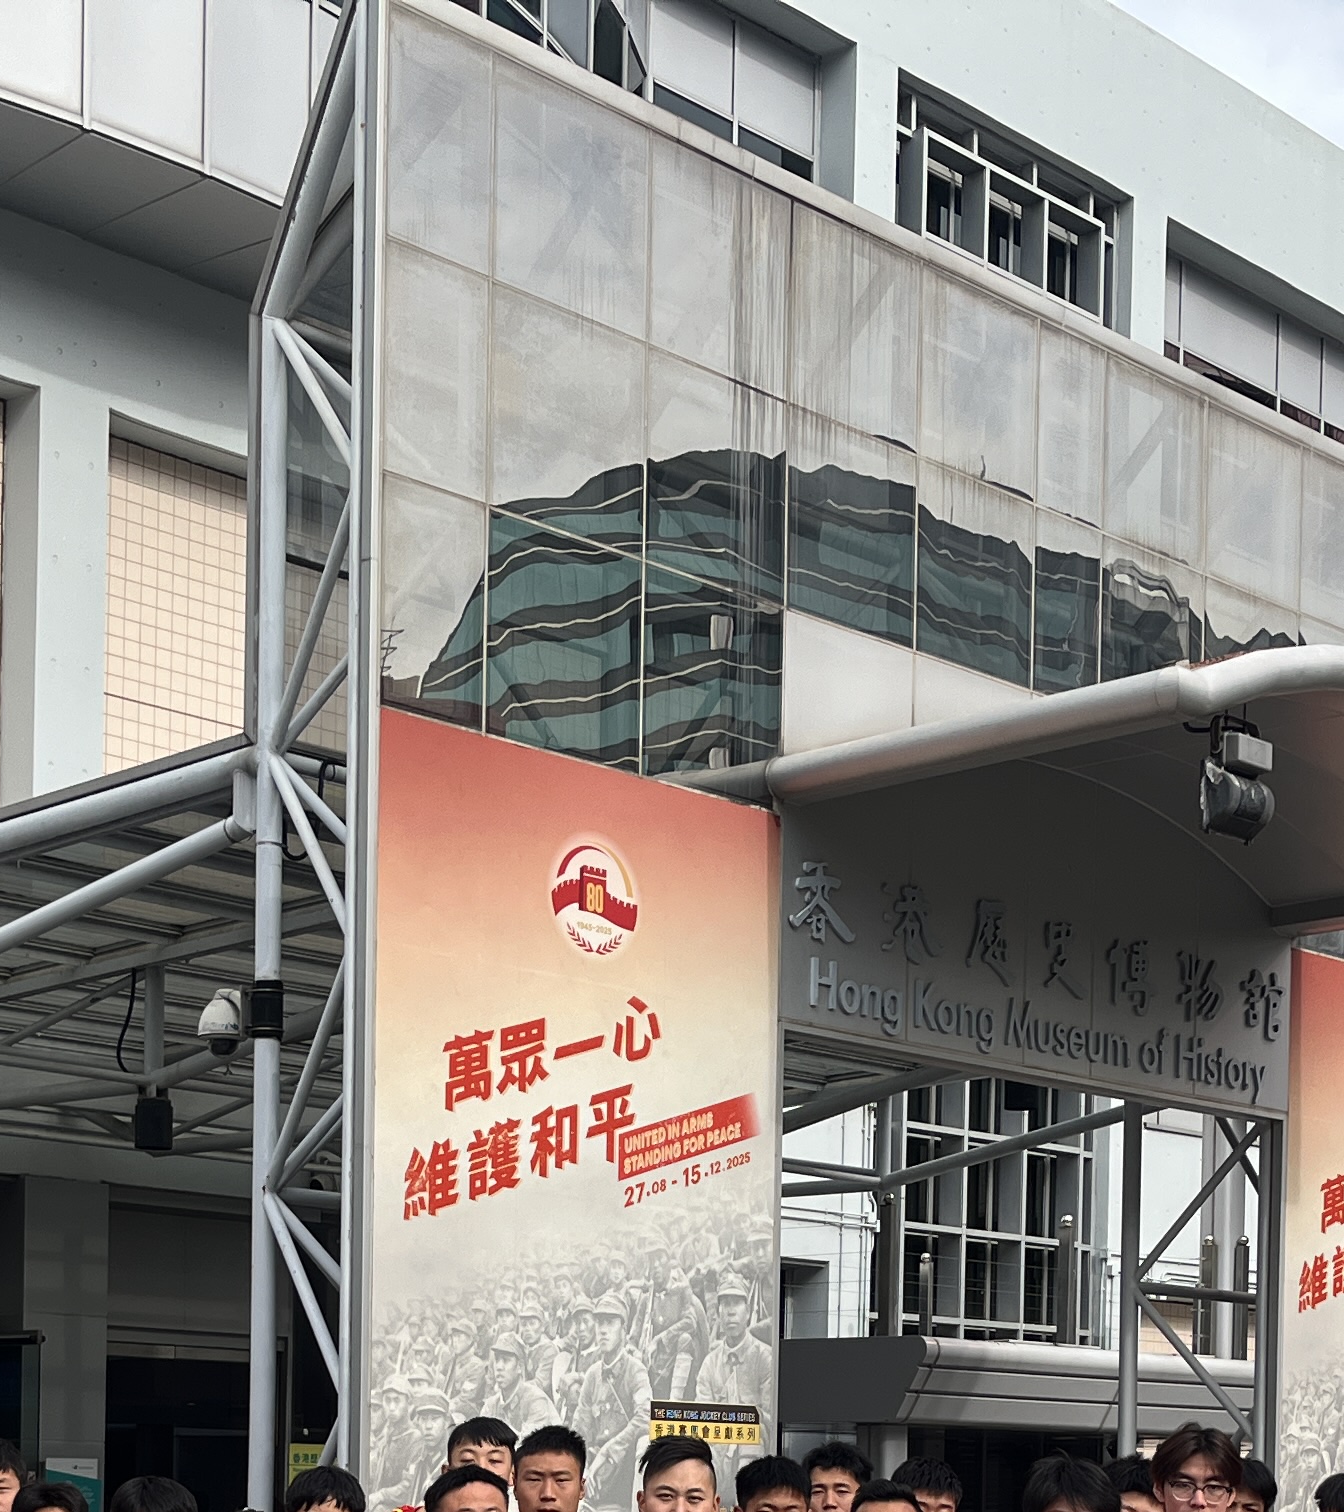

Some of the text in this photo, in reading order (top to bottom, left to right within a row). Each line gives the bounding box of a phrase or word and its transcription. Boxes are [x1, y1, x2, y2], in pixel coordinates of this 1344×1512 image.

[586, 882, 604, 914] 80
[442, 995, 663, 1111] 萬眾一心
[808, 956, 1265, 1105] Hong Kong Museum of History
[403, 1083, 637, 1221] 維護和平
[623, 1122, 741, 1174] STANDING FOR PEACE
[624, 1111, 714, 1154] UNITED IN ARMS
